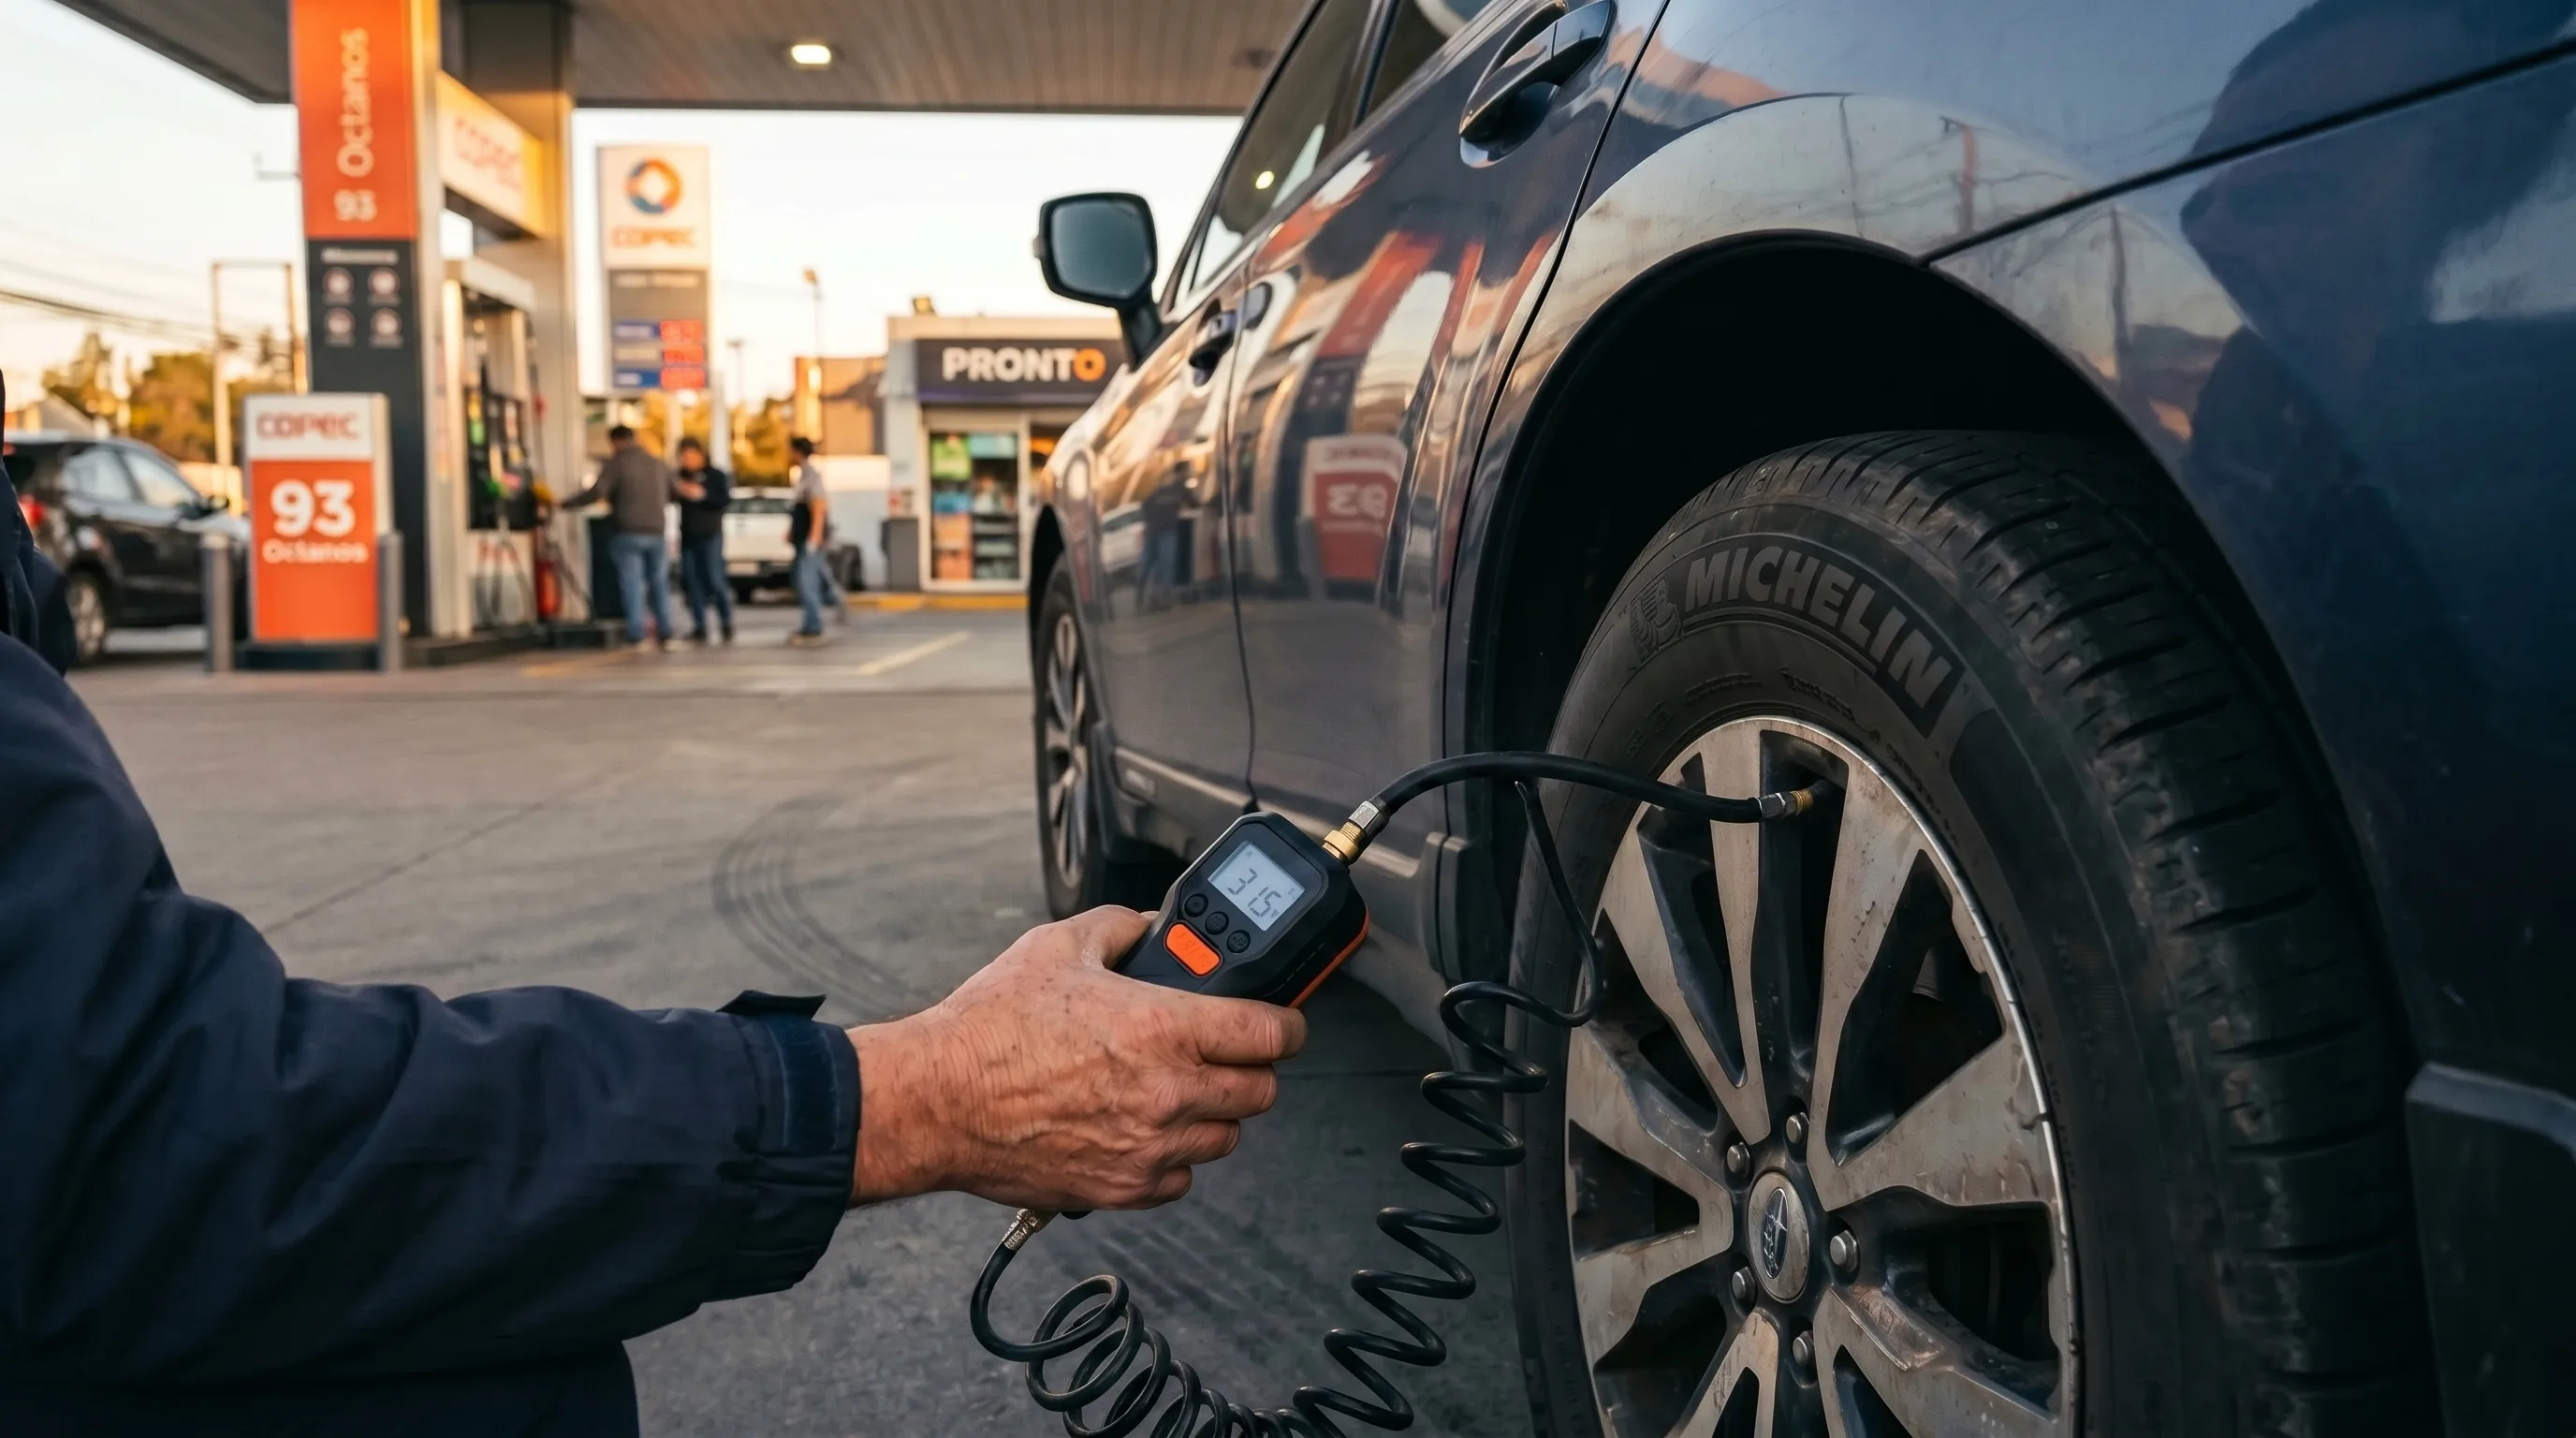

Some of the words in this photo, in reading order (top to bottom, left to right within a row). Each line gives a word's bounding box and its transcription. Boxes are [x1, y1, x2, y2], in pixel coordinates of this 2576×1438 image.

[336, 27, 374, 178] Octanos
[942, 346, 1106, 382] PRONTO
[256, 411, 360, 441] COPEC
[270, 478, 357, 537] 93
[261, 538, 369, 564] Octanos
[1685, 546, 1954, 710] MICHELIN
